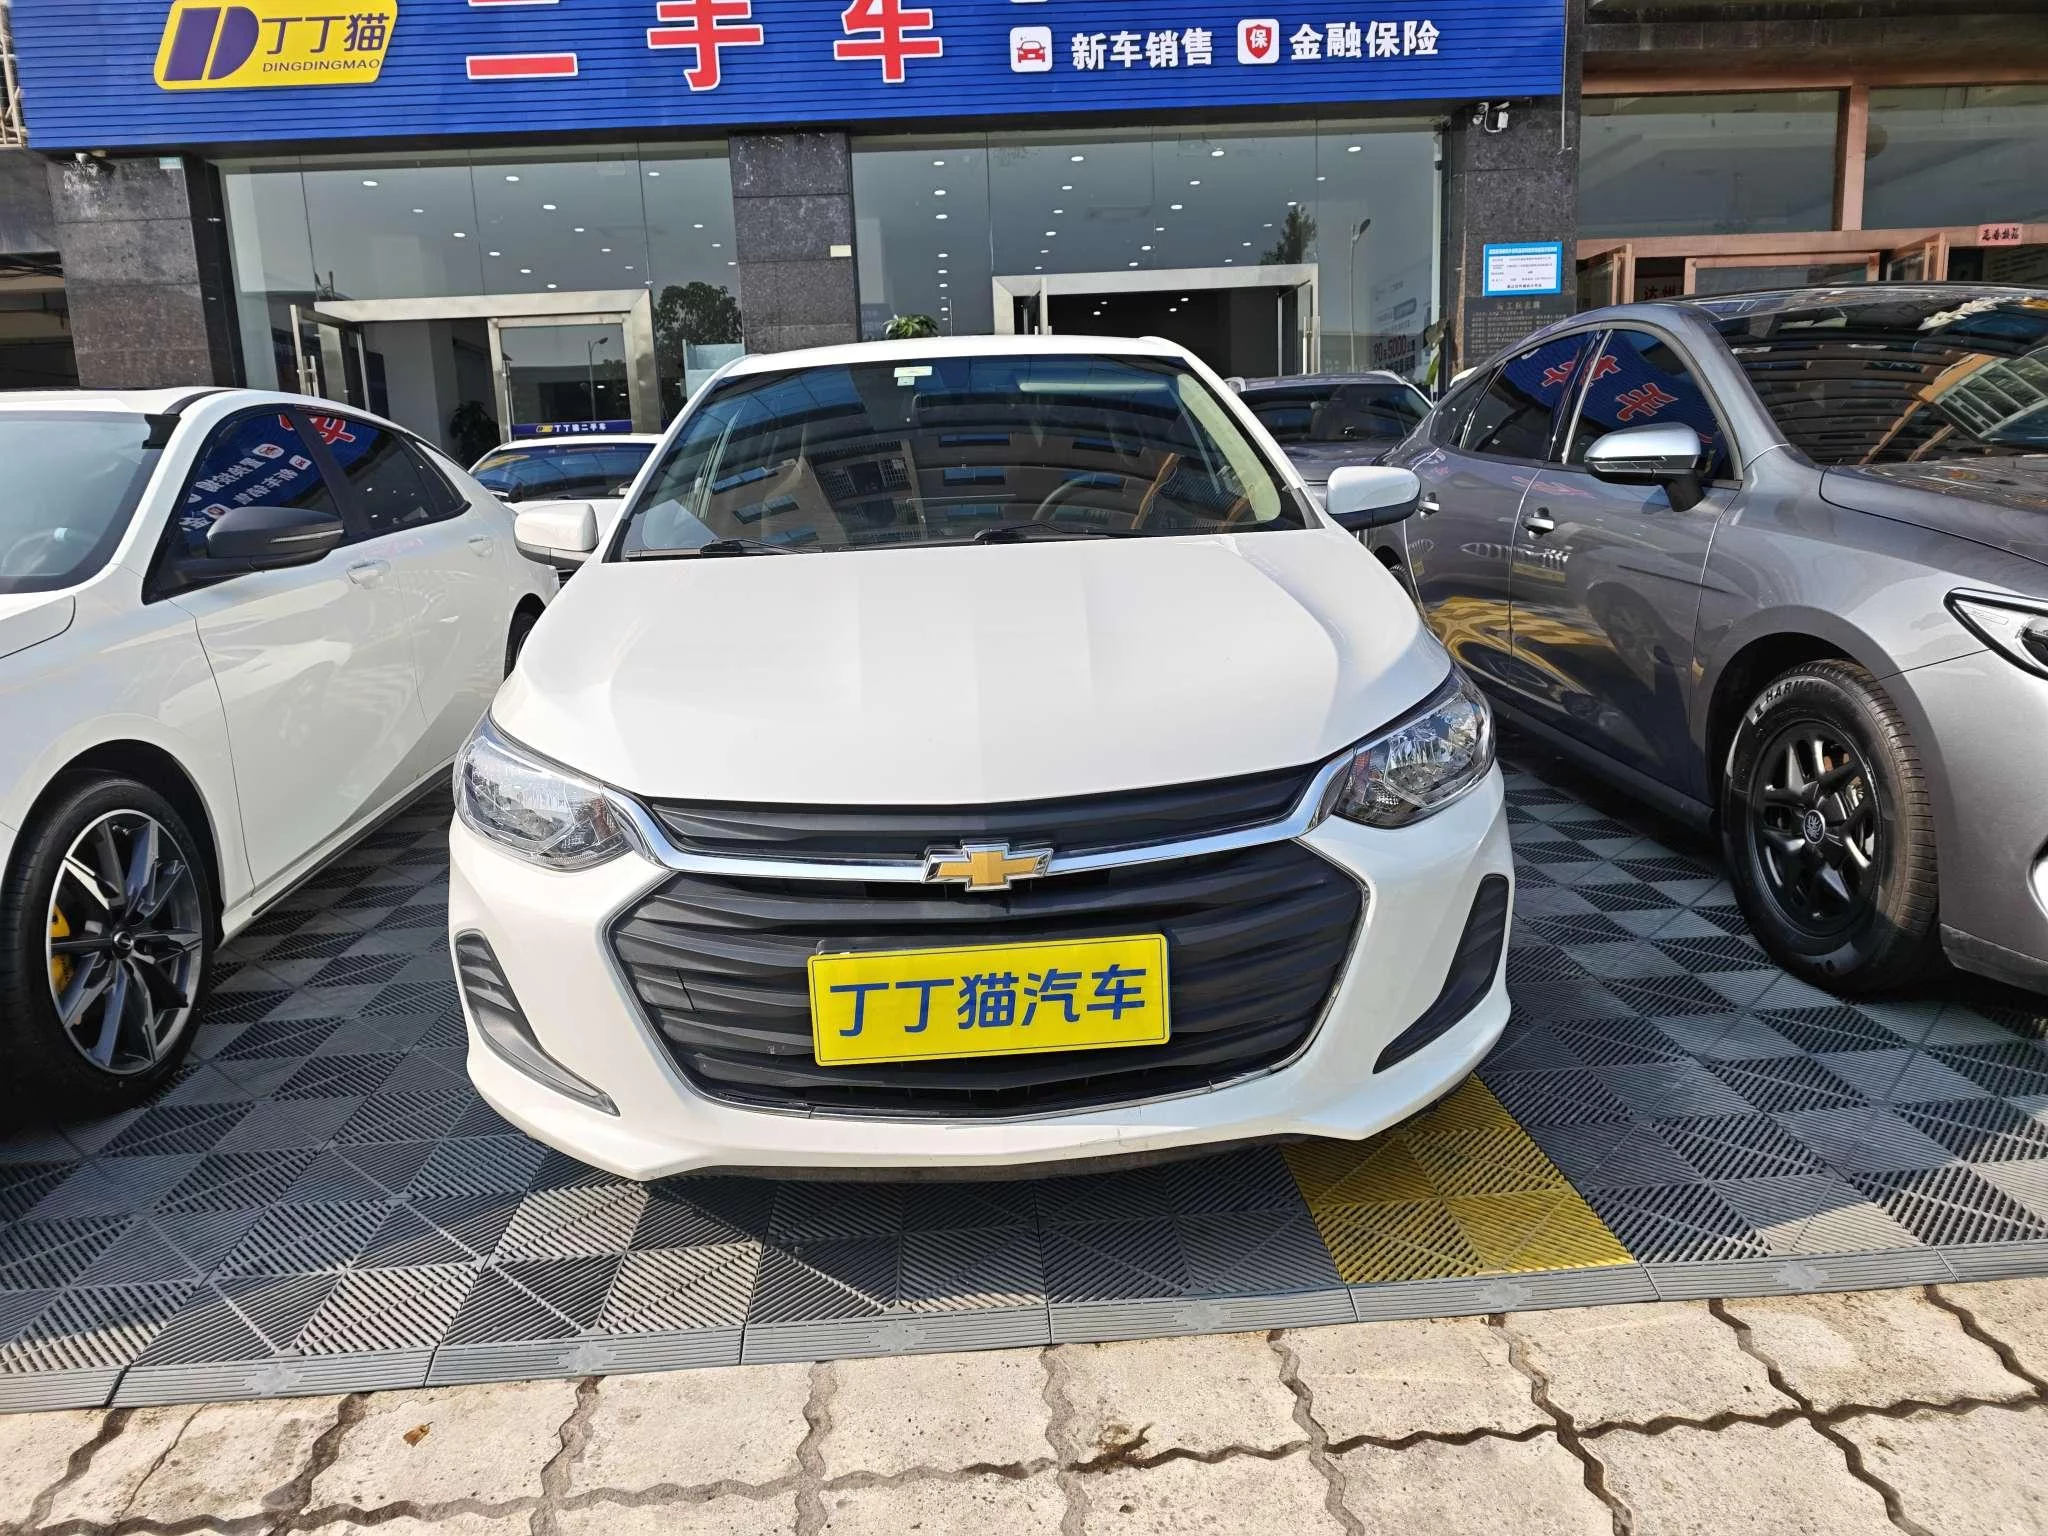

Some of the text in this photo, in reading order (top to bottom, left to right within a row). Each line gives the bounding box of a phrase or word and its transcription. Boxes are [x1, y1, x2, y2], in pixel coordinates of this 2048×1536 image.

[262, 12, 390, 56] 丁丁猫
[466, 0, 943, 91] 二手车
[1071, 26, 1214, 72] 新车销售
[1249, 27, 1269, 50] 保
[1288, 19, 1441, 62] 金融保险
[262, 58, 381, 73] DINGDINGMAO
[829, 963, 1148, 1038] 丁丁猫汽车
